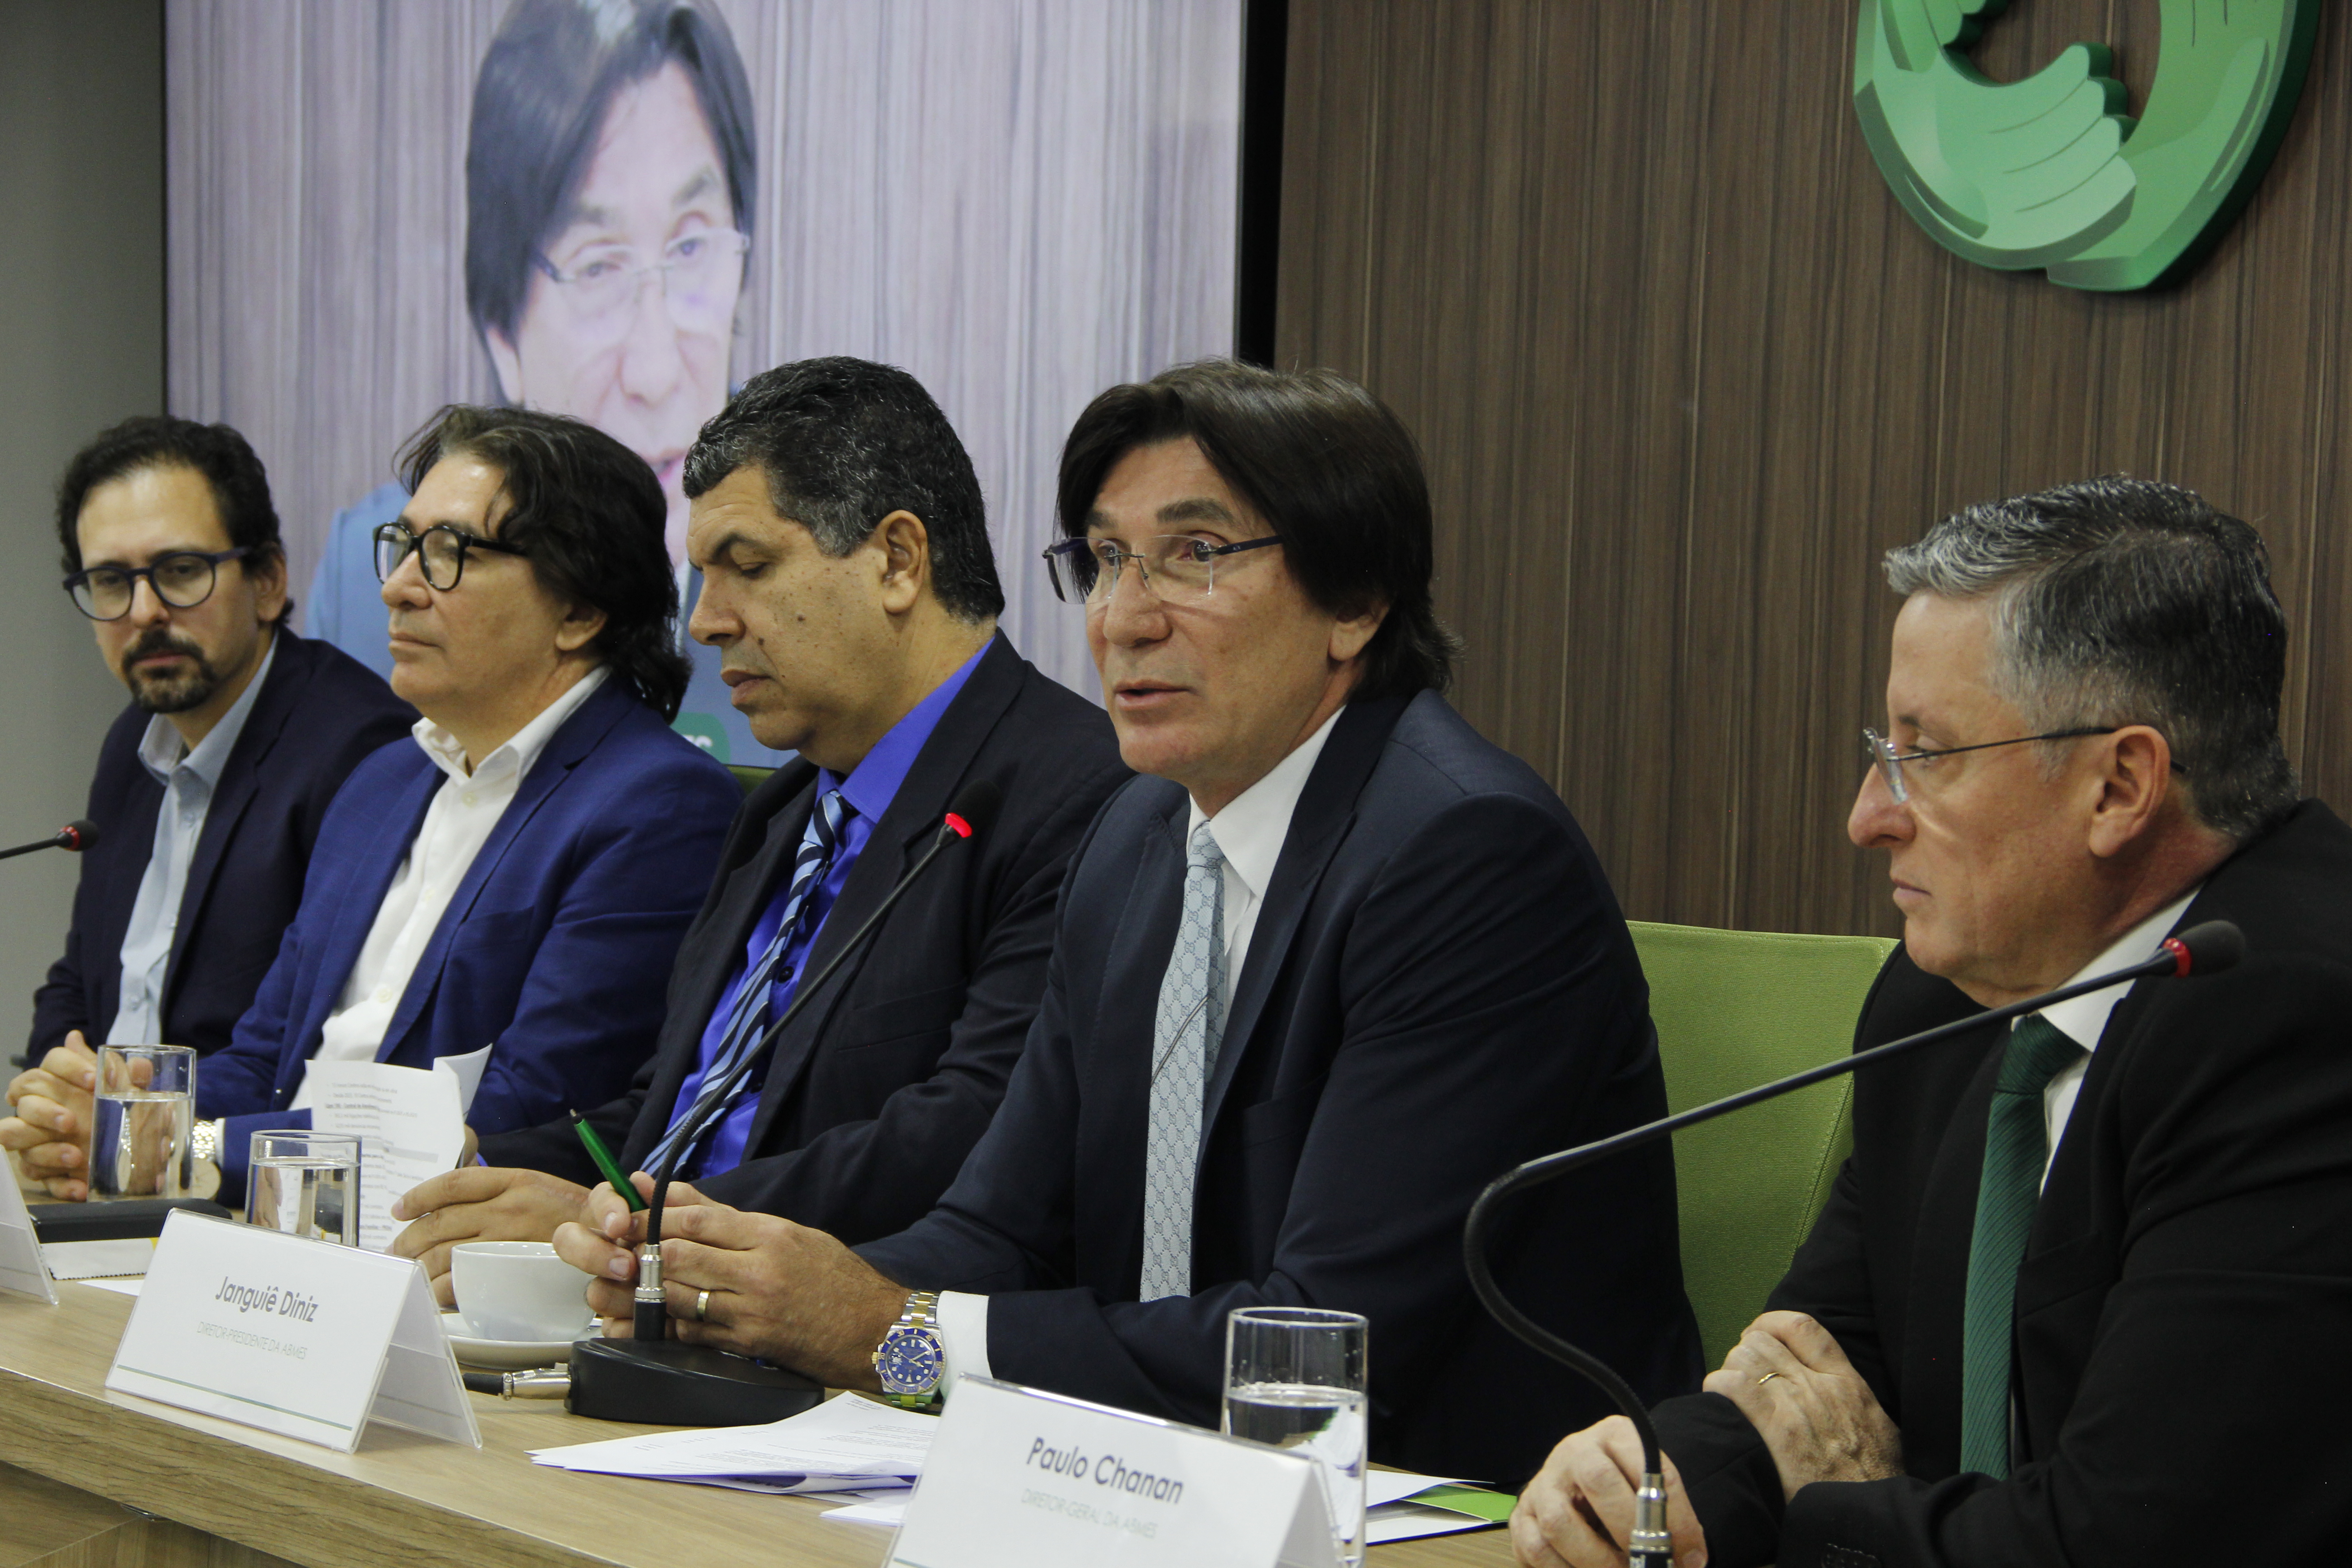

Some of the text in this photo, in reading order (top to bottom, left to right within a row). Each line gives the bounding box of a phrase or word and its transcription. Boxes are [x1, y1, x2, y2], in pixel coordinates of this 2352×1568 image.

[215, 1275, 318, 1322] Janguiê Diniz
[196, 1321, 308, 1360] DIRETOR-PRESIDENTE DA ABMES
[1026, 1436, 1183, 1504] Paulo Chanan
